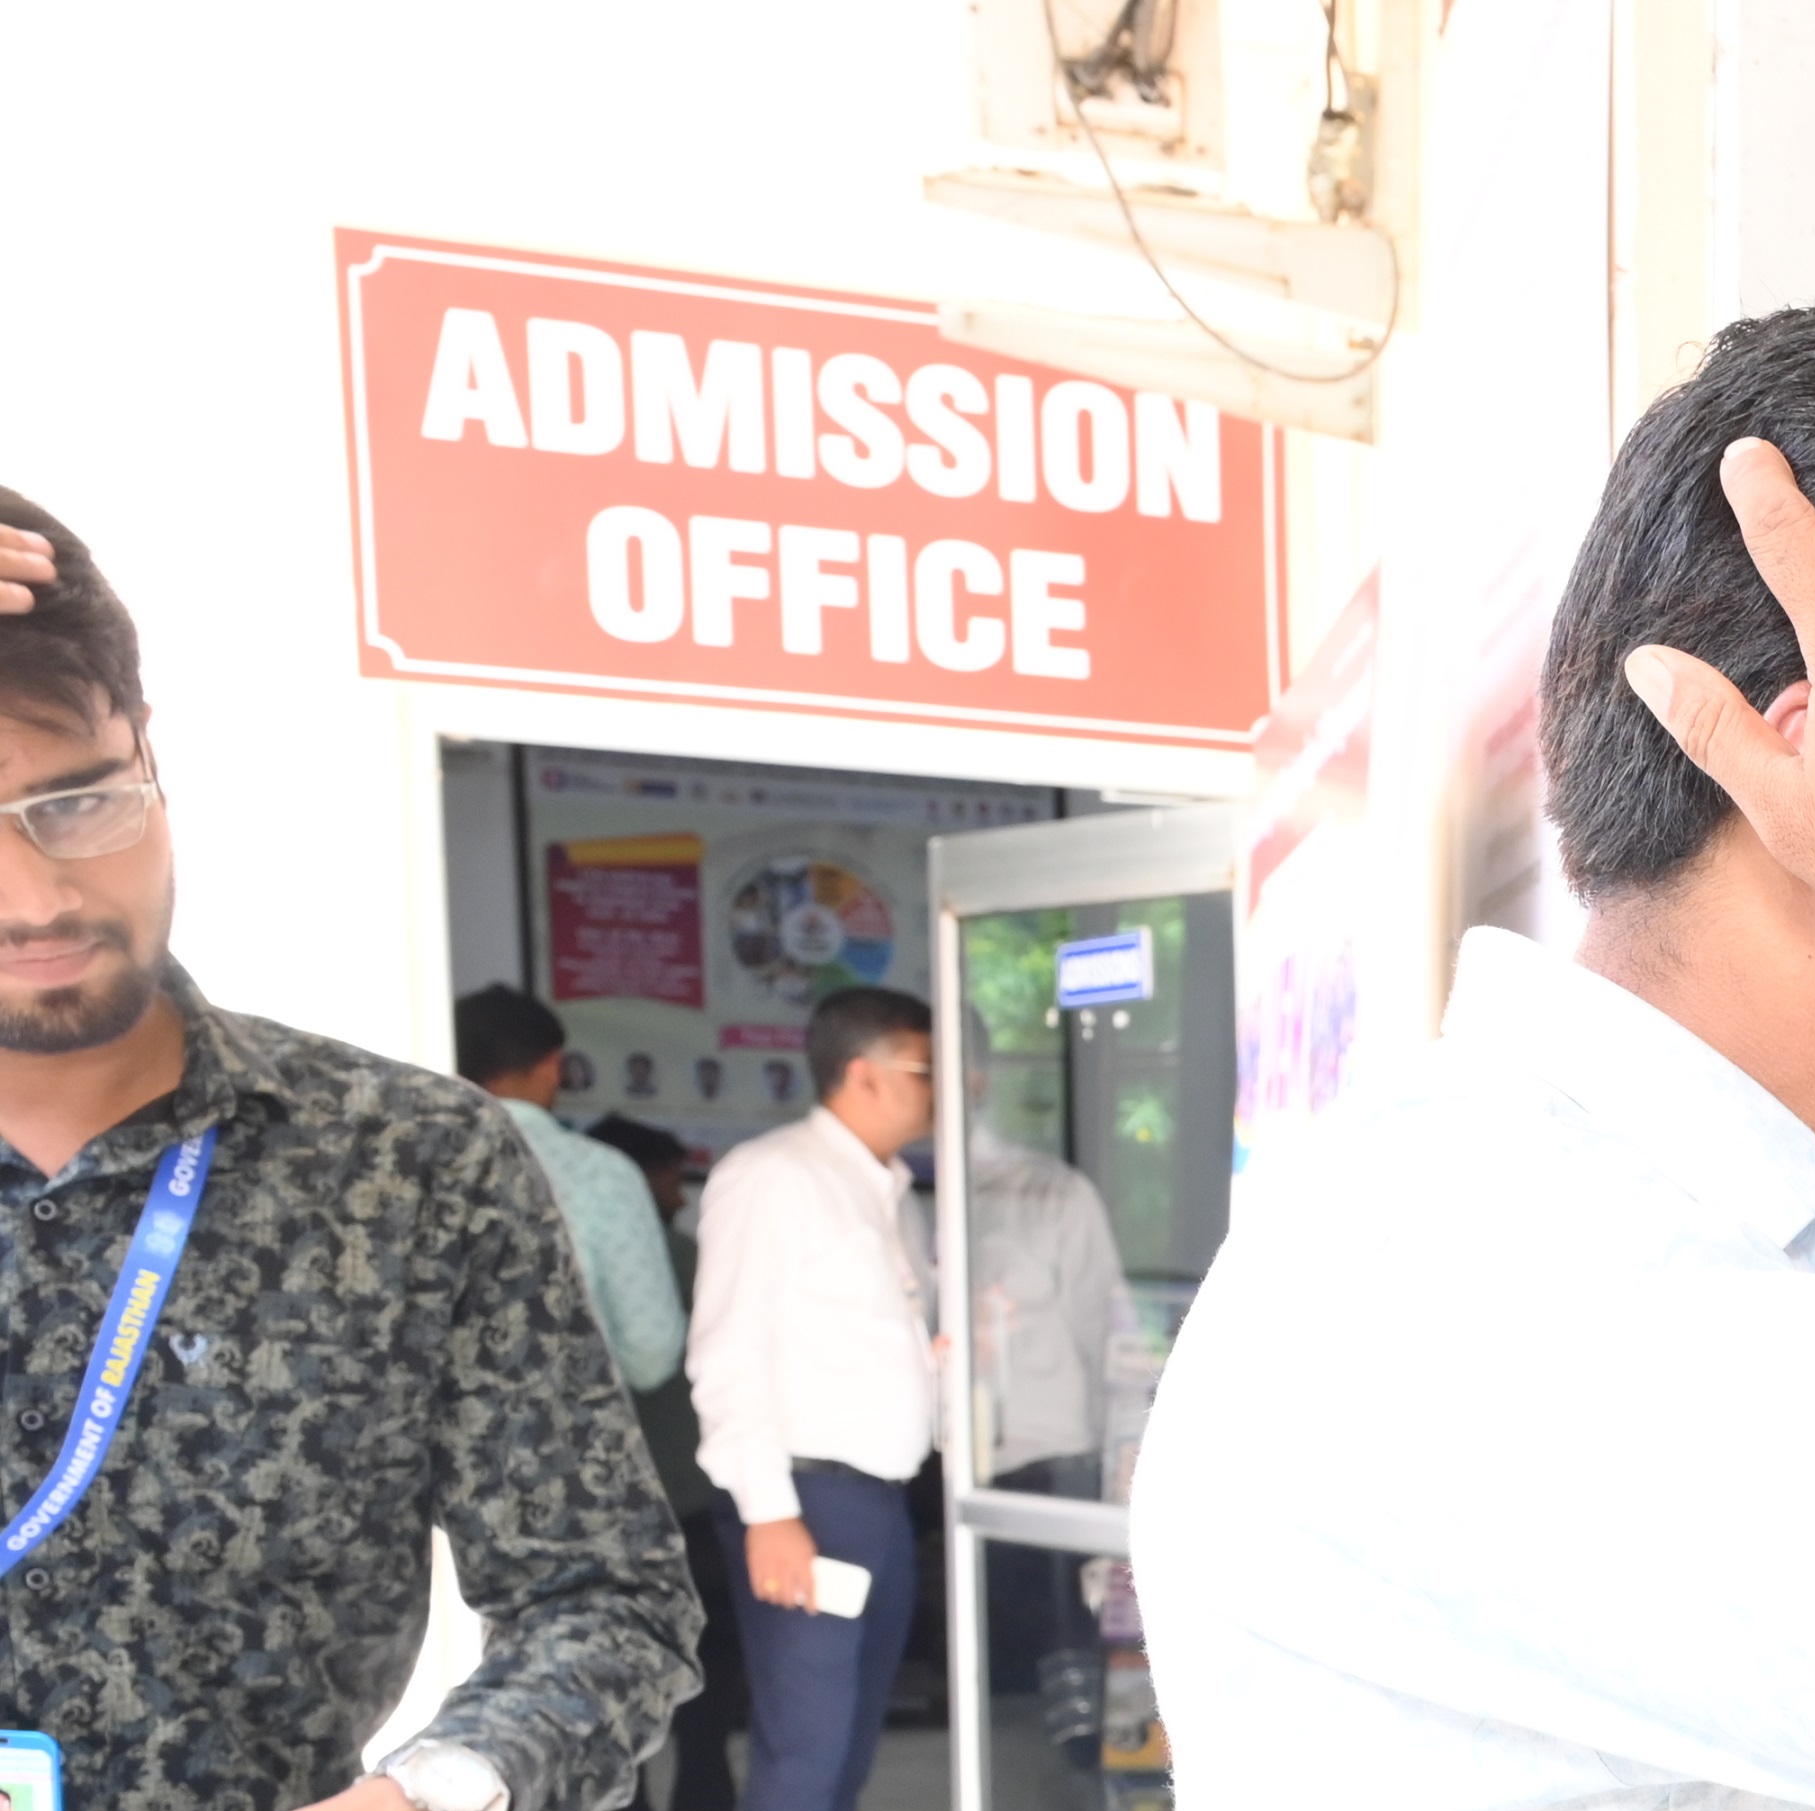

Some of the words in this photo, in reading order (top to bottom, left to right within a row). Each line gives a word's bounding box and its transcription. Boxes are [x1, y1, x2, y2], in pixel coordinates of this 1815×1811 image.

[419, 306, 1221, 524] ADMISSION
[584, 503, 1092, 681] OFFICE
[100, 1268, 163, 1388] RAJASTHAN
[89, 1386, 119, 1420] OF
[6, 1416, 107, 1553] GOVERNMENT
